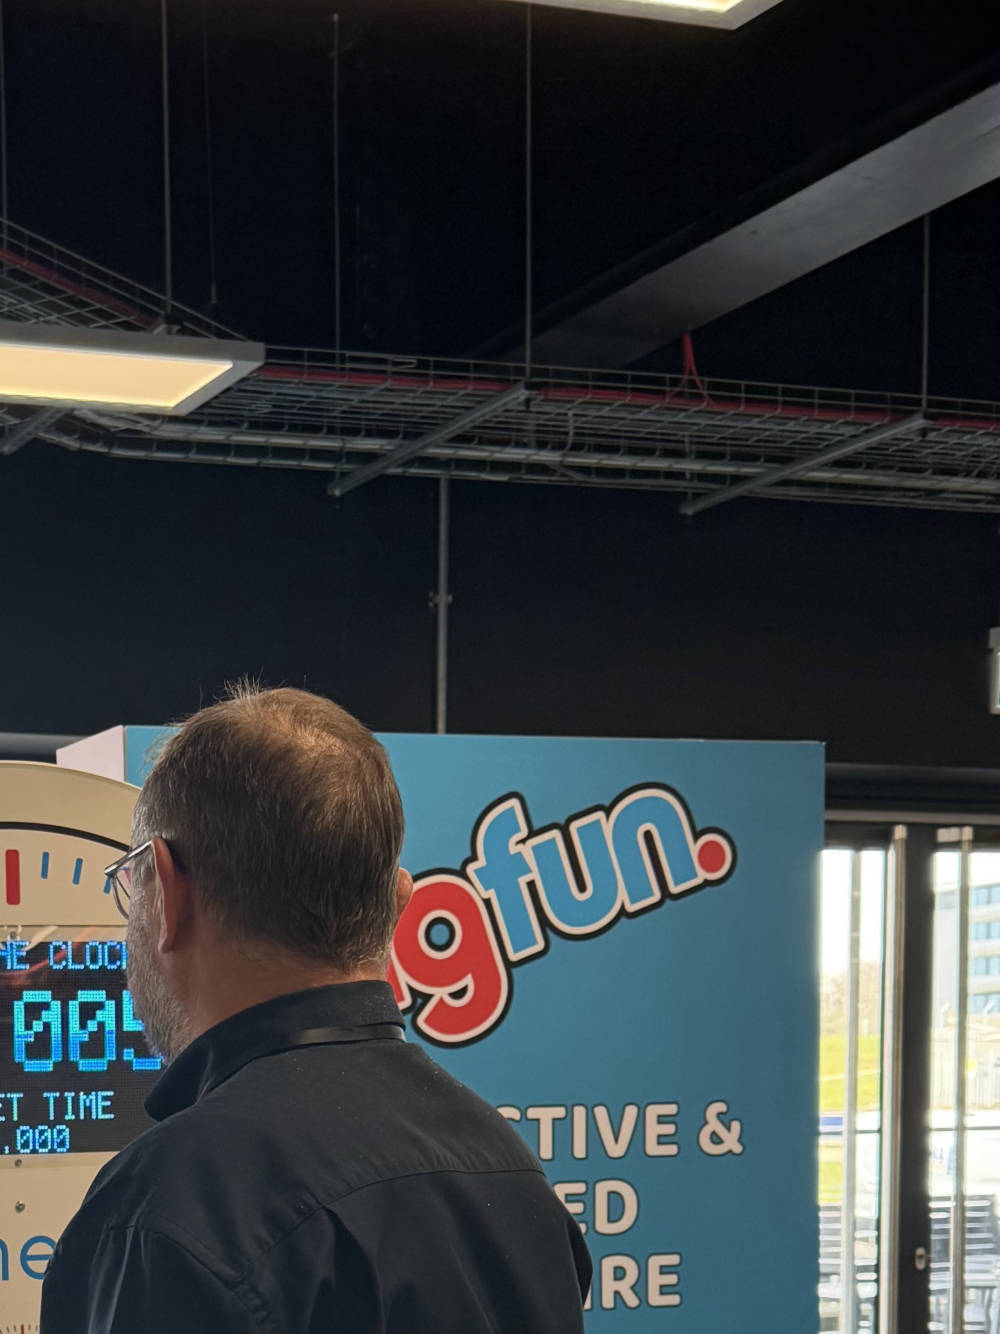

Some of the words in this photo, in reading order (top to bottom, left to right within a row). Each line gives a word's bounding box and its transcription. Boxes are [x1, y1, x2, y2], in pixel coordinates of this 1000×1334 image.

[48, 940, 128, 970] CLOC
[43, 1091, 115, 1120] TIME
[698, 1100, 744, 1156] &
